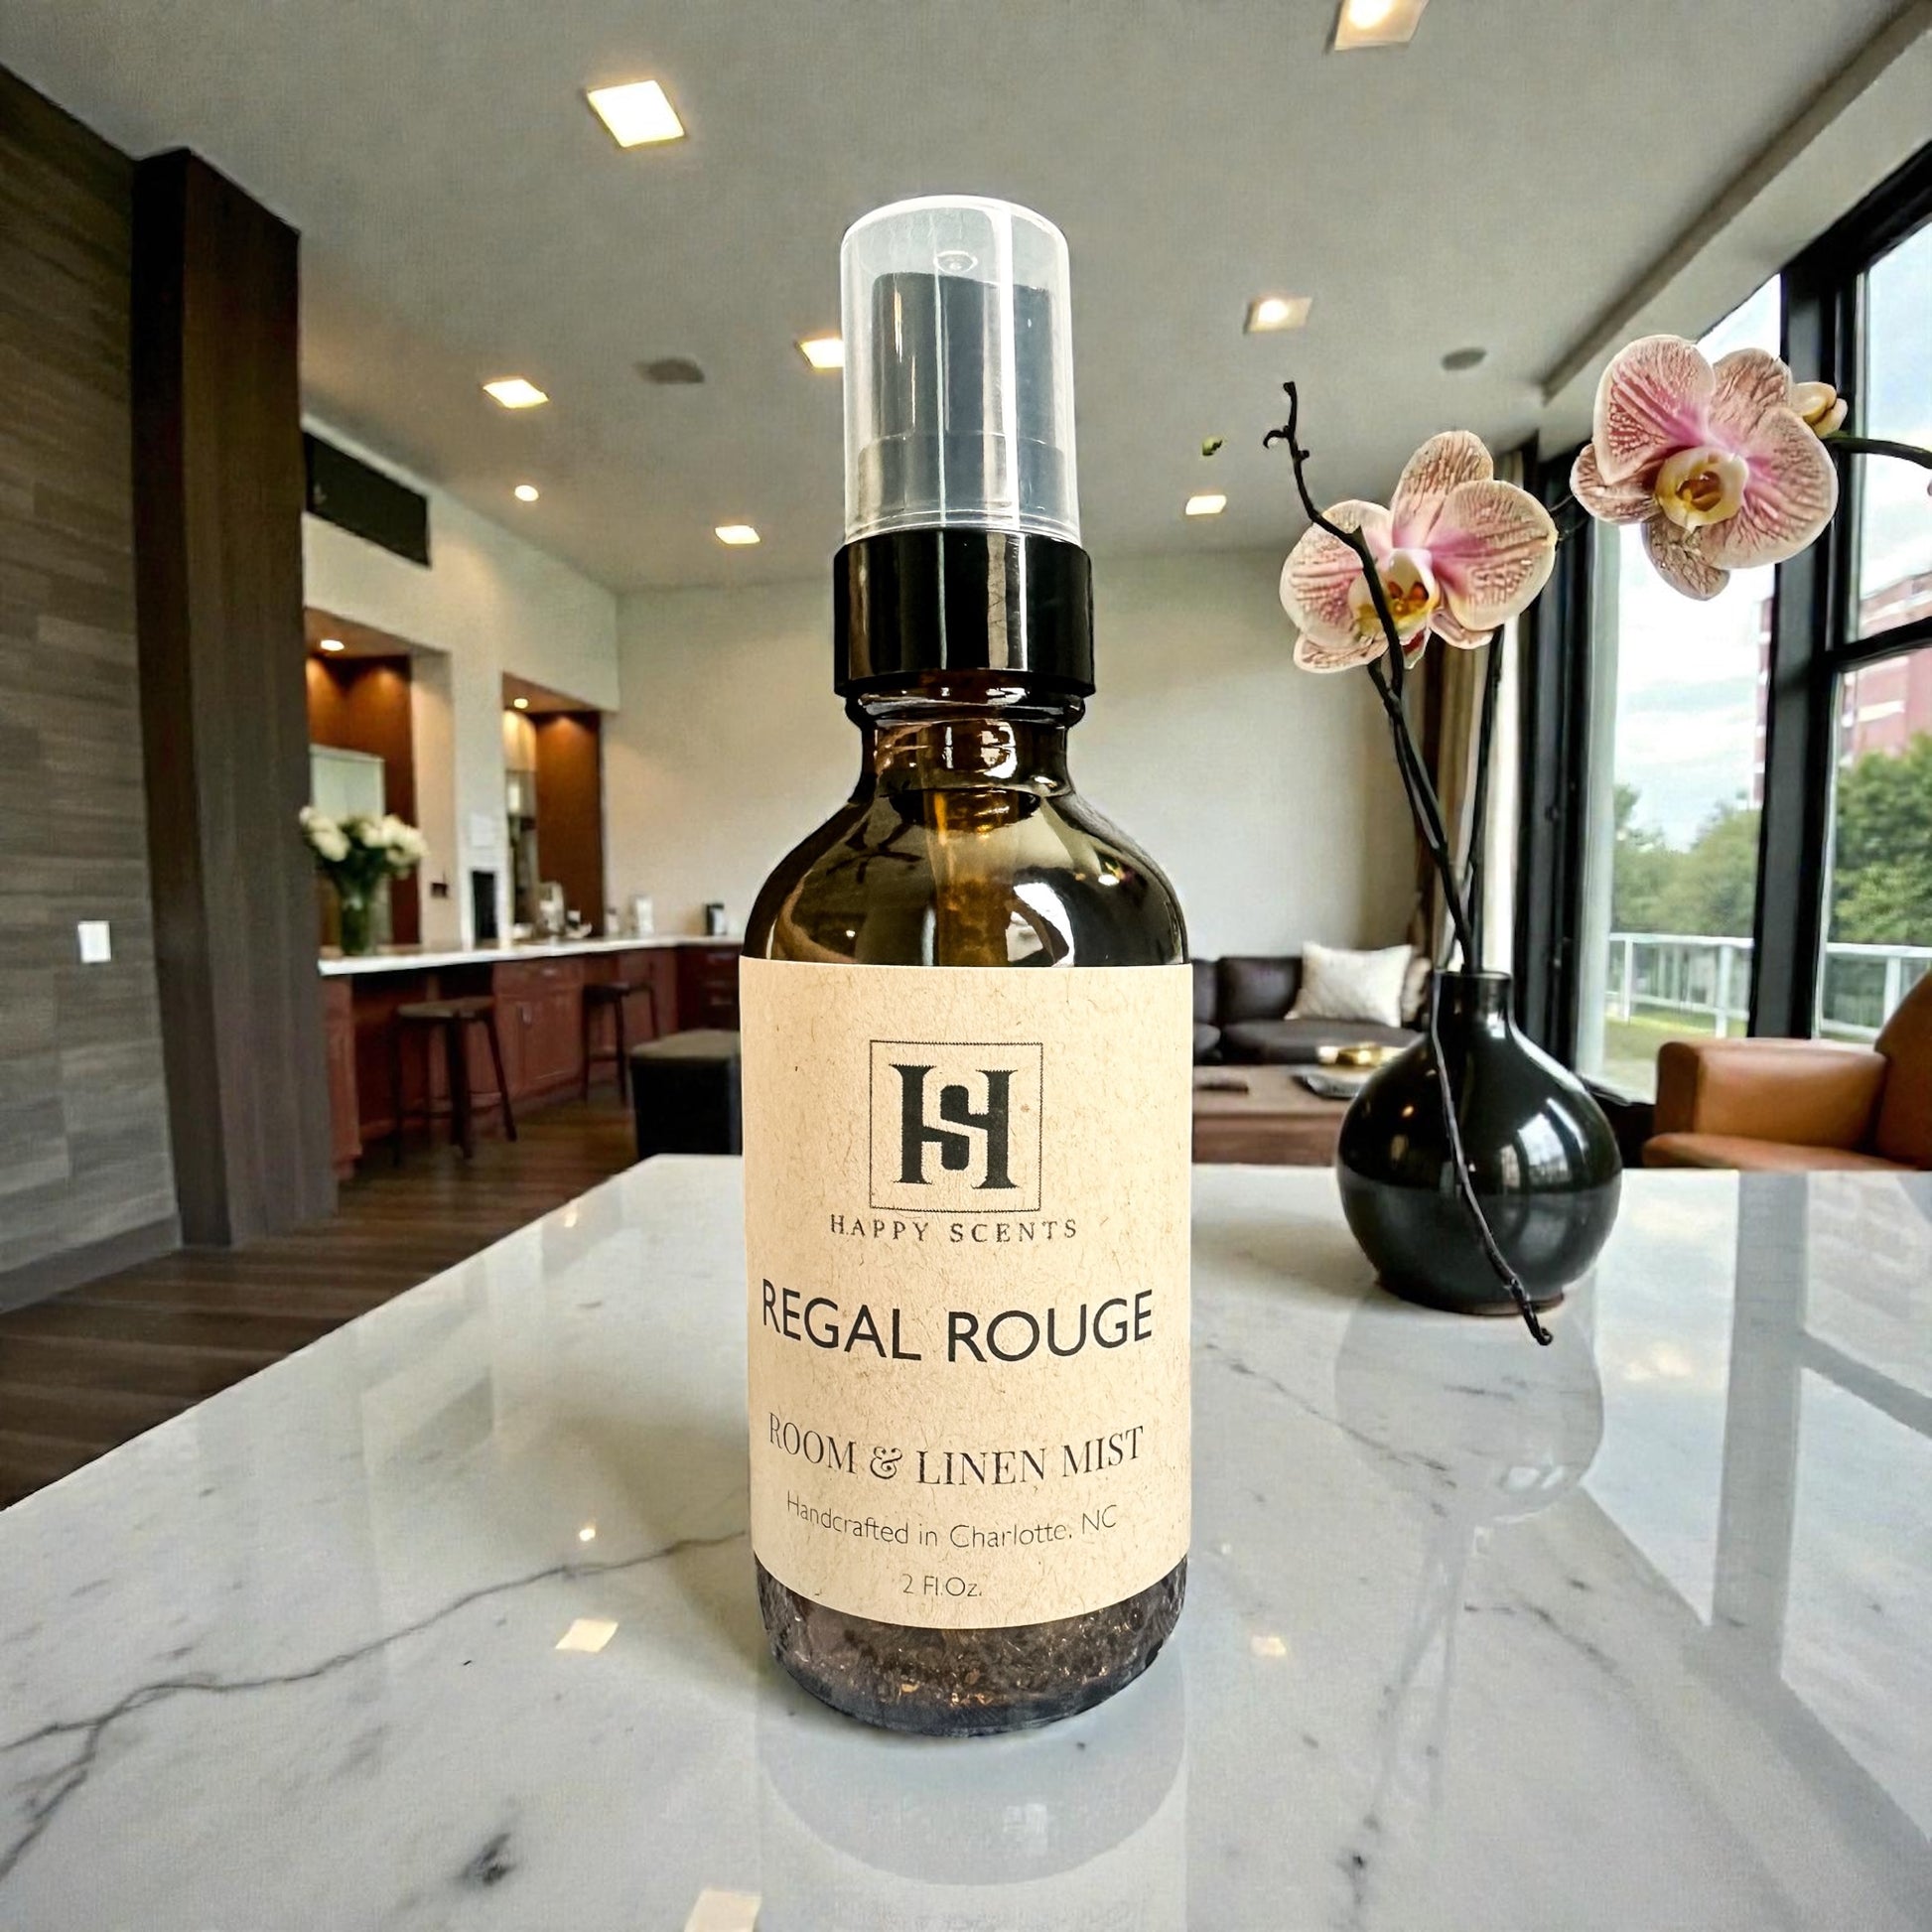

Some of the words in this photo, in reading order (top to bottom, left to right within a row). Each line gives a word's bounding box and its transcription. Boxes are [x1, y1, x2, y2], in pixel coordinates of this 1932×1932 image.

[830, 1214, 929, 1242] HAPPY
[950, 1219, 1077, 1243] SCENTS
[762, 1278, 921, 1361] REGAL
[947, 1289, 1153, 1362] ROUGE
[768, 1412, 857, 1474] ROOM
[869, 1446, 903, 1479] &
[915, 1447, 1046, 1485] LINEN
[1061, 1425, 1144, 1477] MIST
[787, 1490, 908, 1544] Handcrafted
[918, 1523, 938, 1546] in
[1082, 1504, 1117, 1534] NC
[901, 1573, 914, 1594] 2
